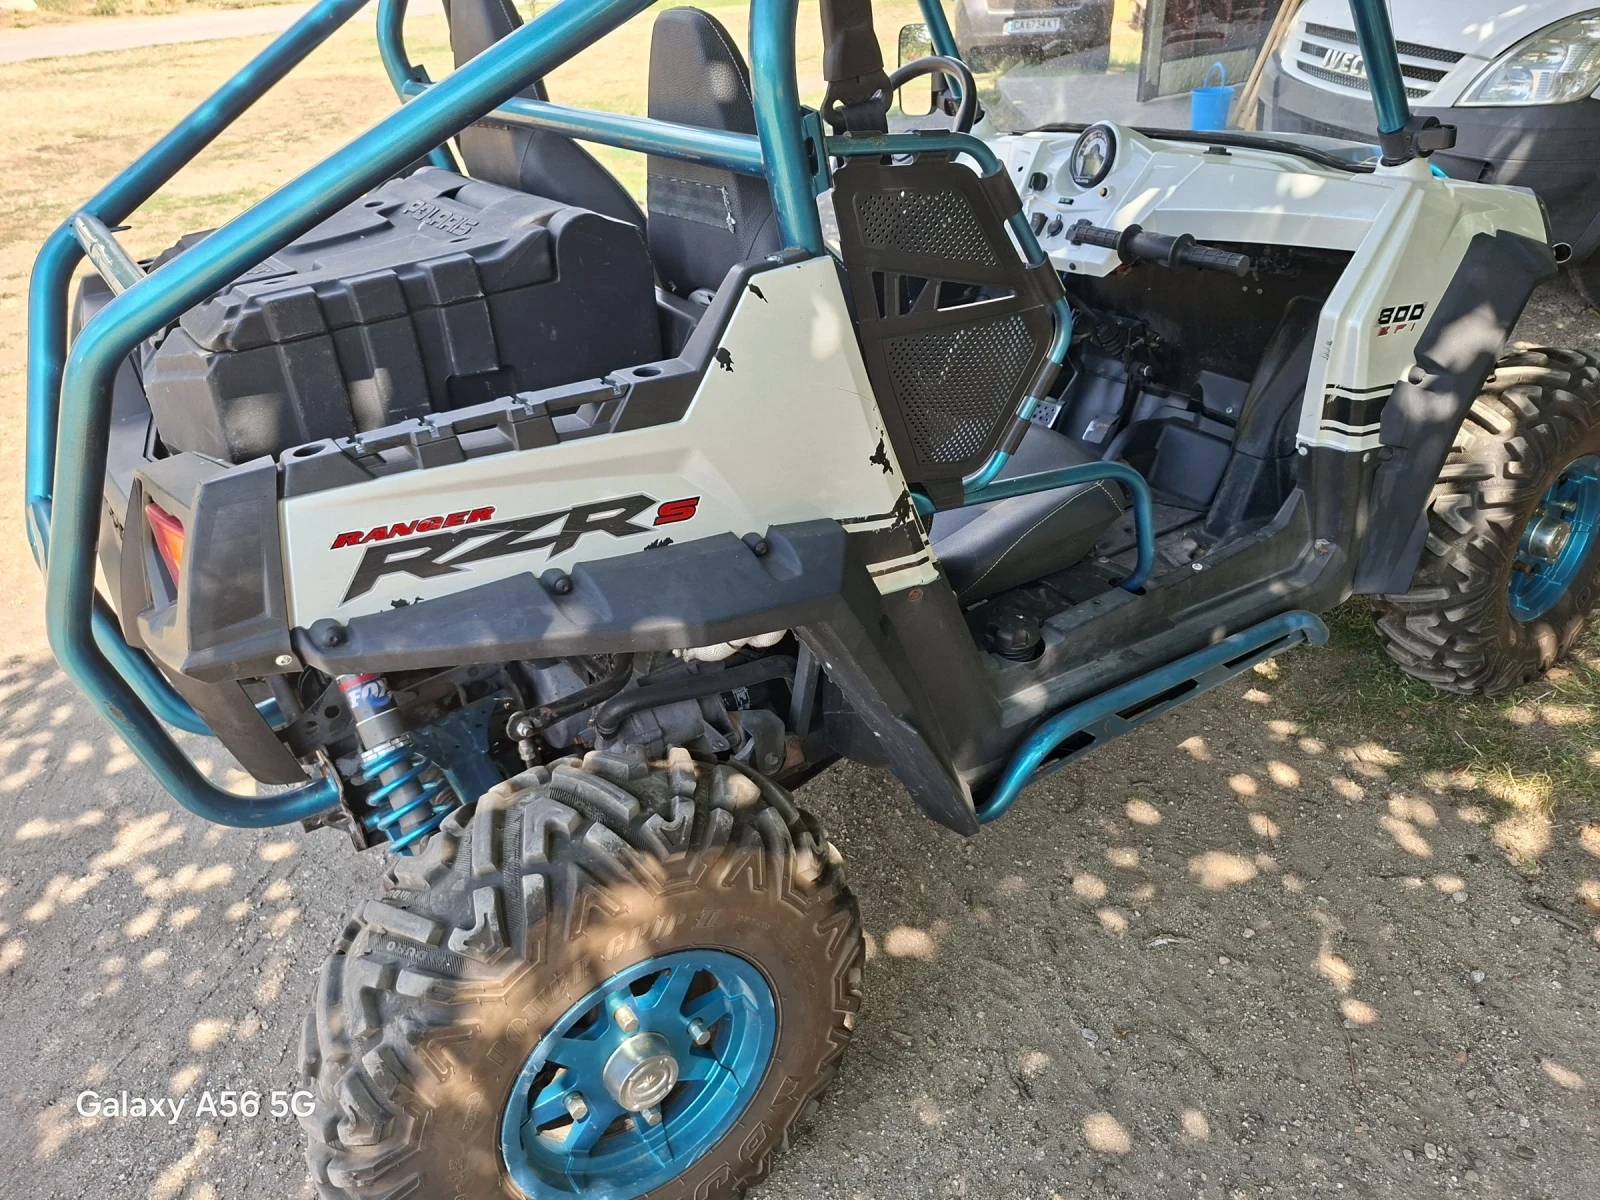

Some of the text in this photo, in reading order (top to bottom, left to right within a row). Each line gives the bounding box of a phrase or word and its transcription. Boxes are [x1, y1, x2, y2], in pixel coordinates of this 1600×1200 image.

[1322, 48, 1367, 77] IVEC
[402, 200, 479, 236] POLARIS
[1377, 303, 1425, 325] 800
[330, 505, 497, 550] RANGER
[338, 493, 701, 606] RZR S
[603, 912, 688, 961] GRIP
